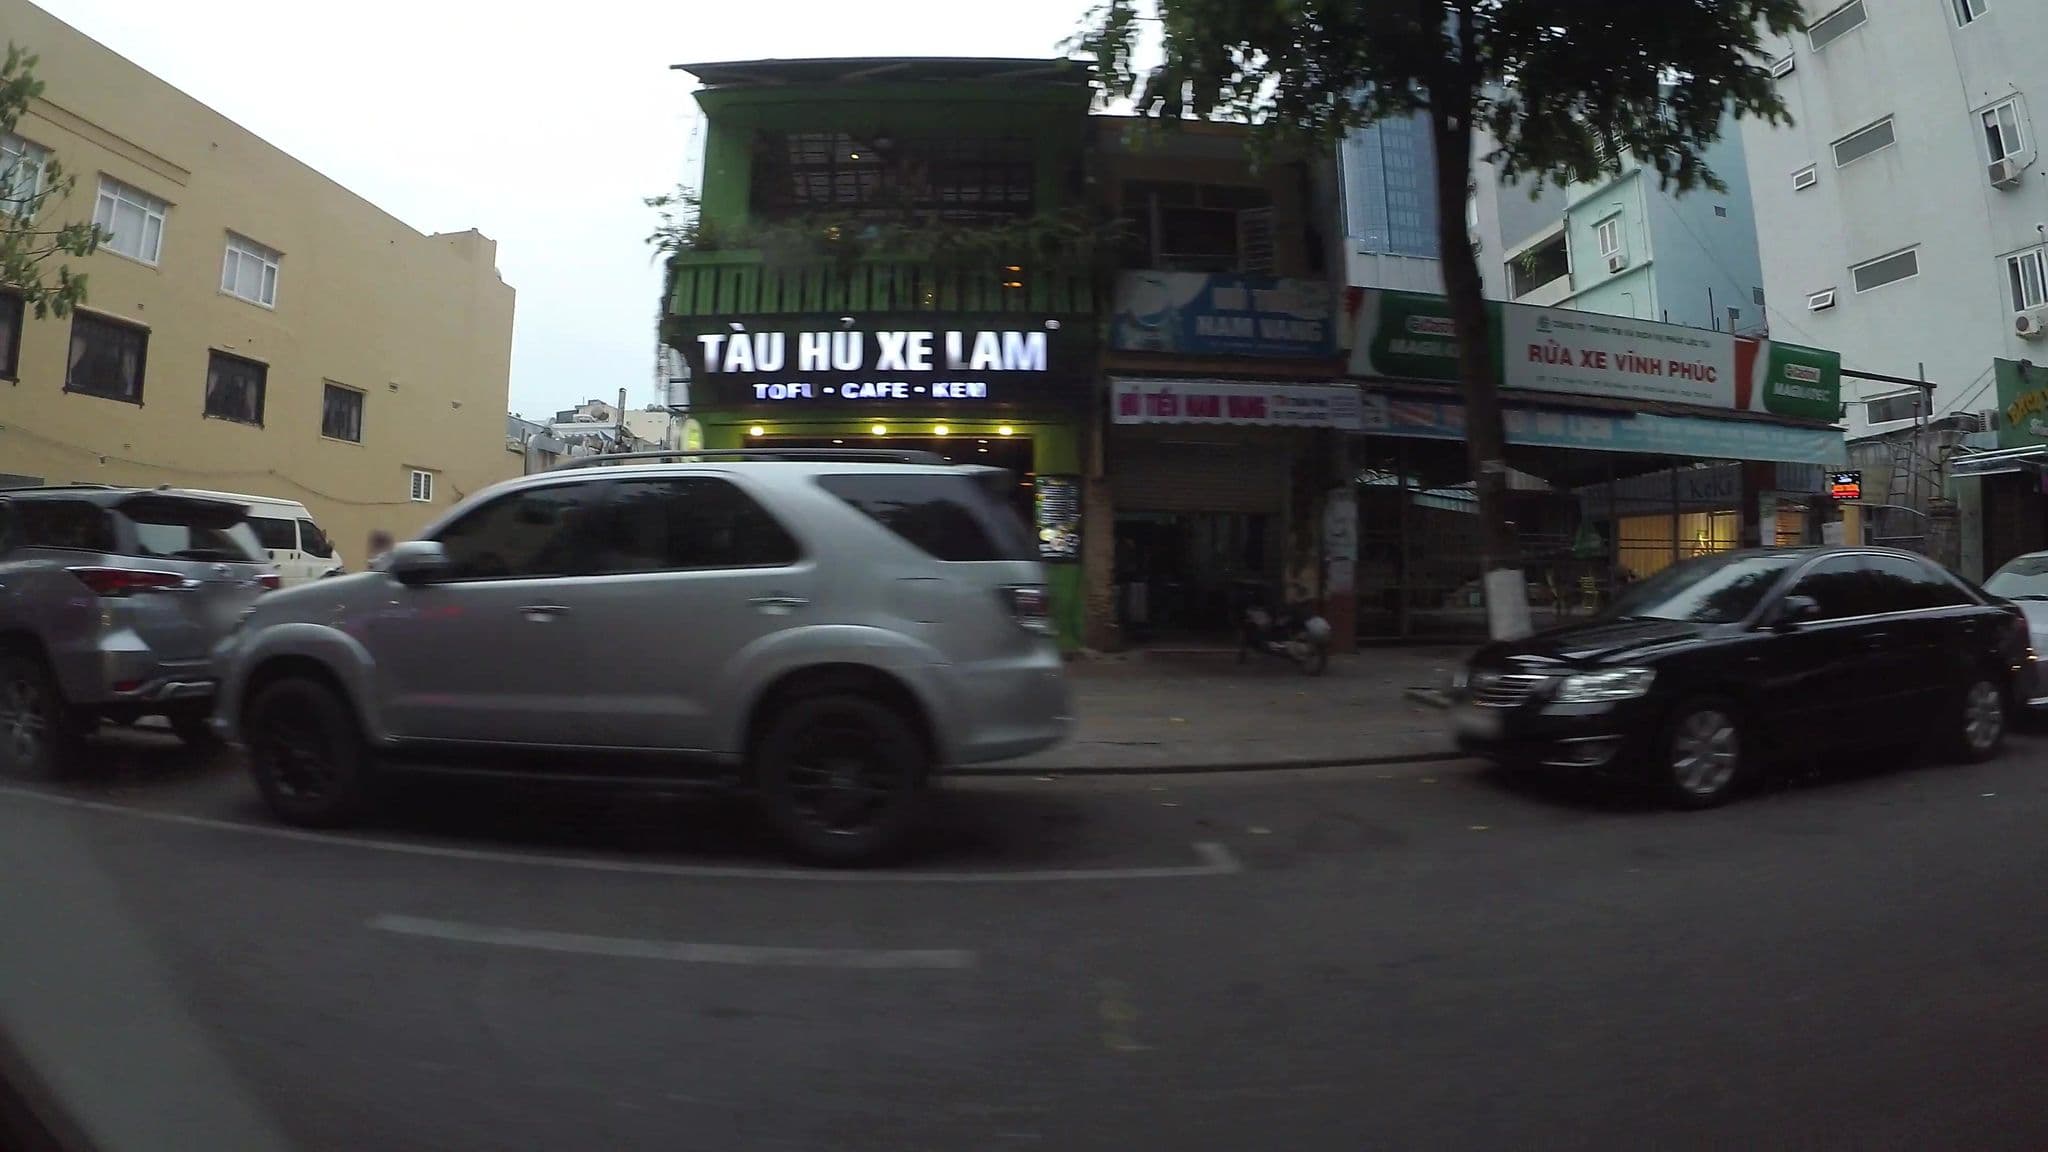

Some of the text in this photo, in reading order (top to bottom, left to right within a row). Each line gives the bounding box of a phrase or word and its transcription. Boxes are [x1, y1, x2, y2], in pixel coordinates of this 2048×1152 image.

[697, 316, 1048, 373] TÀU HỦ XE LAM
[1527, 339, 1573, 366] RỬA
[1580, 349, 1608, 370] XE
[1668, 359, 1718, 383] PHÚC
[841, 382, 909, 399] CAFE
